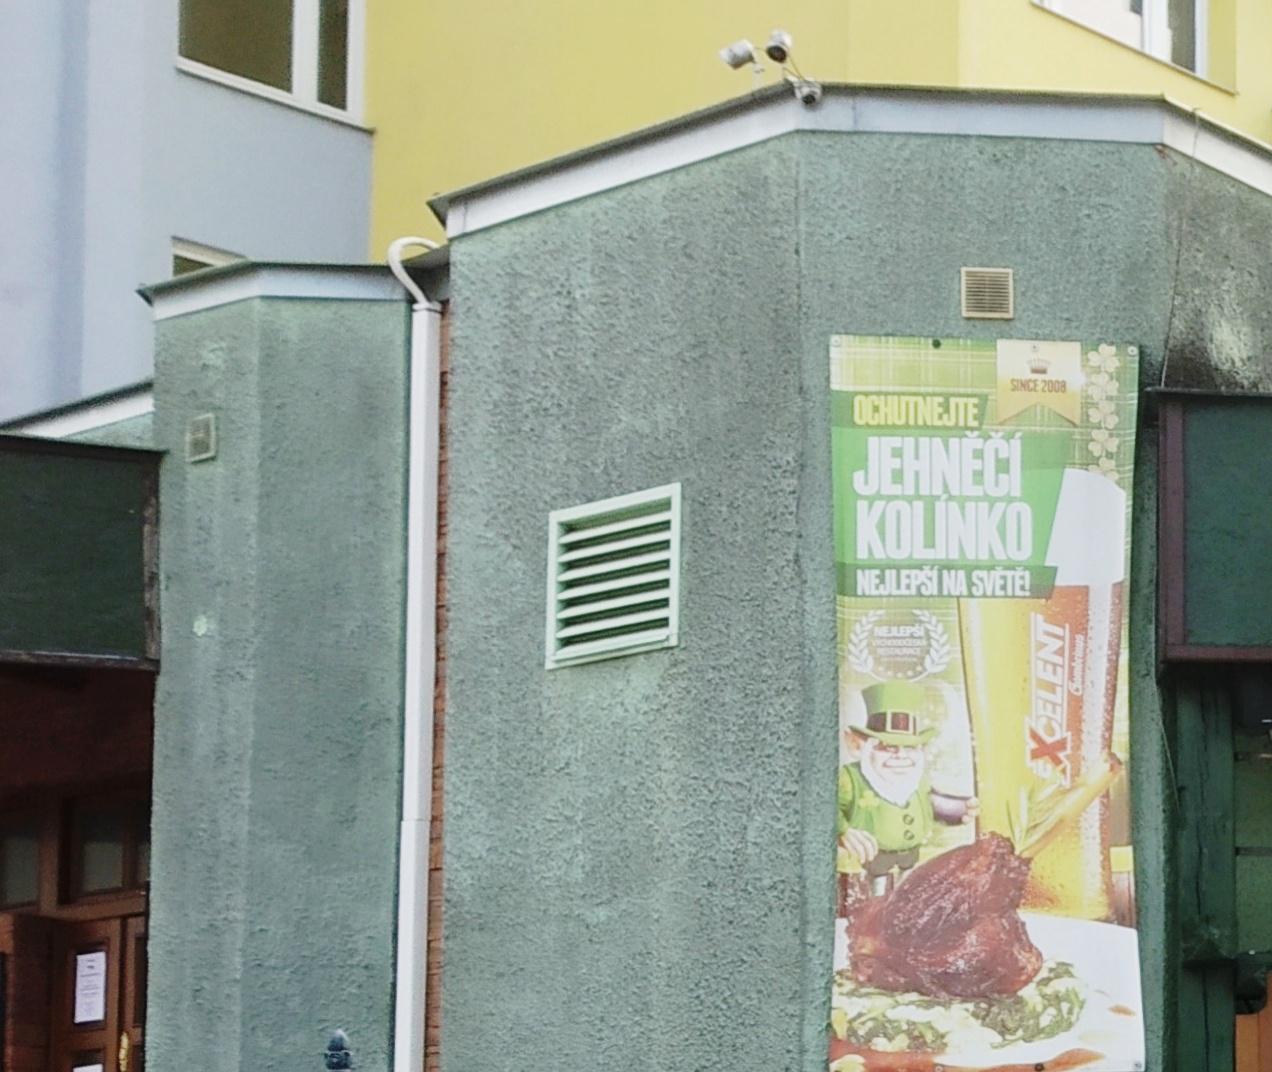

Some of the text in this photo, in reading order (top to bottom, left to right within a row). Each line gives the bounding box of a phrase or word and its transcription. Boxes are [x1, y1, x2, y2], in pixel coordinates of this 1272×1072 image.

[1010, 378, 1067, 394] SINCE 2008
[853, 394, 980, 428] OCHUTNEJTE
[853, 430, 1023, 498] JEHNĚČÍ
[856, 493, 1032, 561] KOLÍNKO
[856, 564, 1031, 597] NEJLEPŠÍ NA SVĚTĚ!
